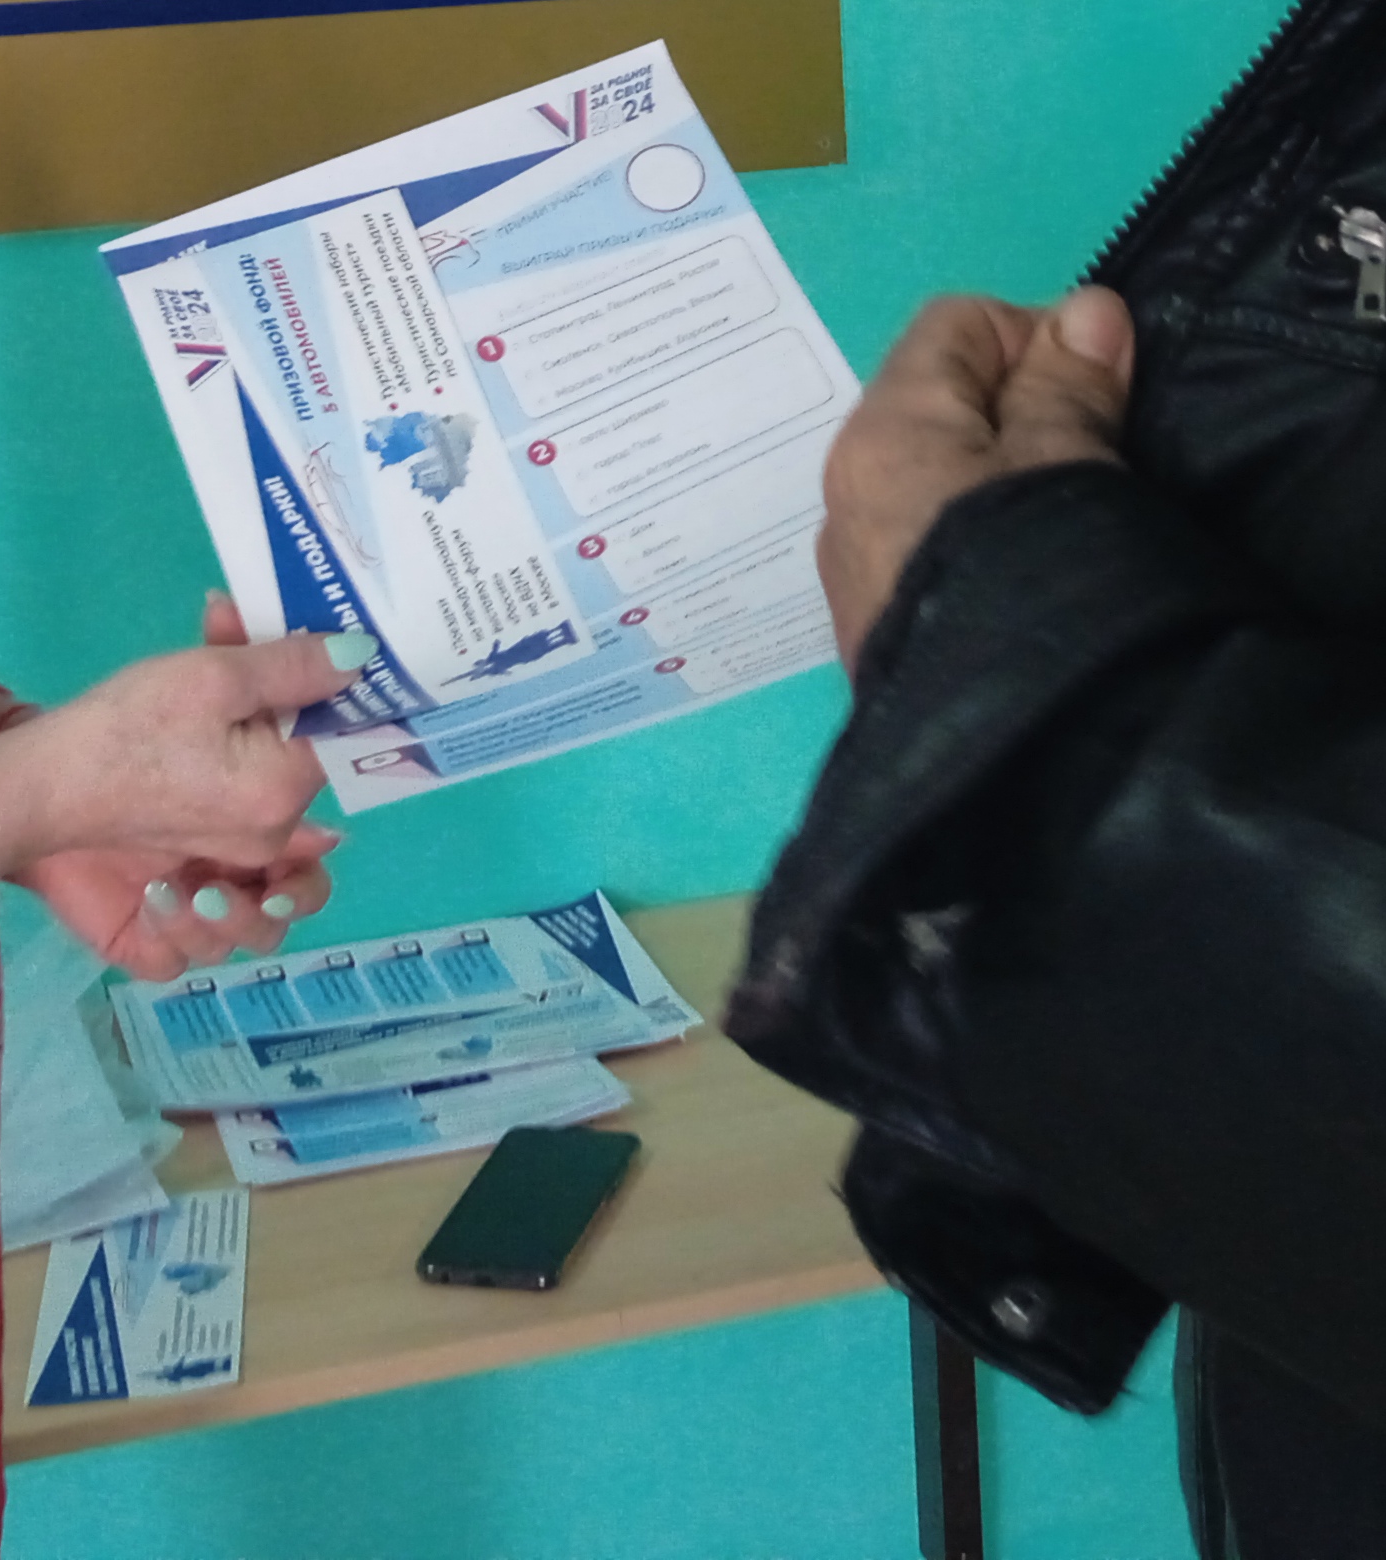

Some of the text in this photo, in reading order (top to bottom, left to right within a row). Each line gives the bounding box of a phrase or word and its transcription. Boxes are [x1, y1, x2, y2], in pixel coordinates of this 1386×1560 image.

[588, 94, 609, 110] ЗА
[261, 254, 335, 401] АВТОМОБИЛЕЙ
[317, 228, 396, 399] Туристические наборы
[343, 239, 414, 394] «Мобильный турист»
[361, 211, 441, 384] Туристические поездки
[380, 210, 458, 378] по Самарской области
[482, 339, 498, 357] 1
[254, 314, 315, 424] ПРИЗОВОЙ
[531, 442, 551, 462] 2
[259, 471, 347, 603] И ПОДАРКИ!
